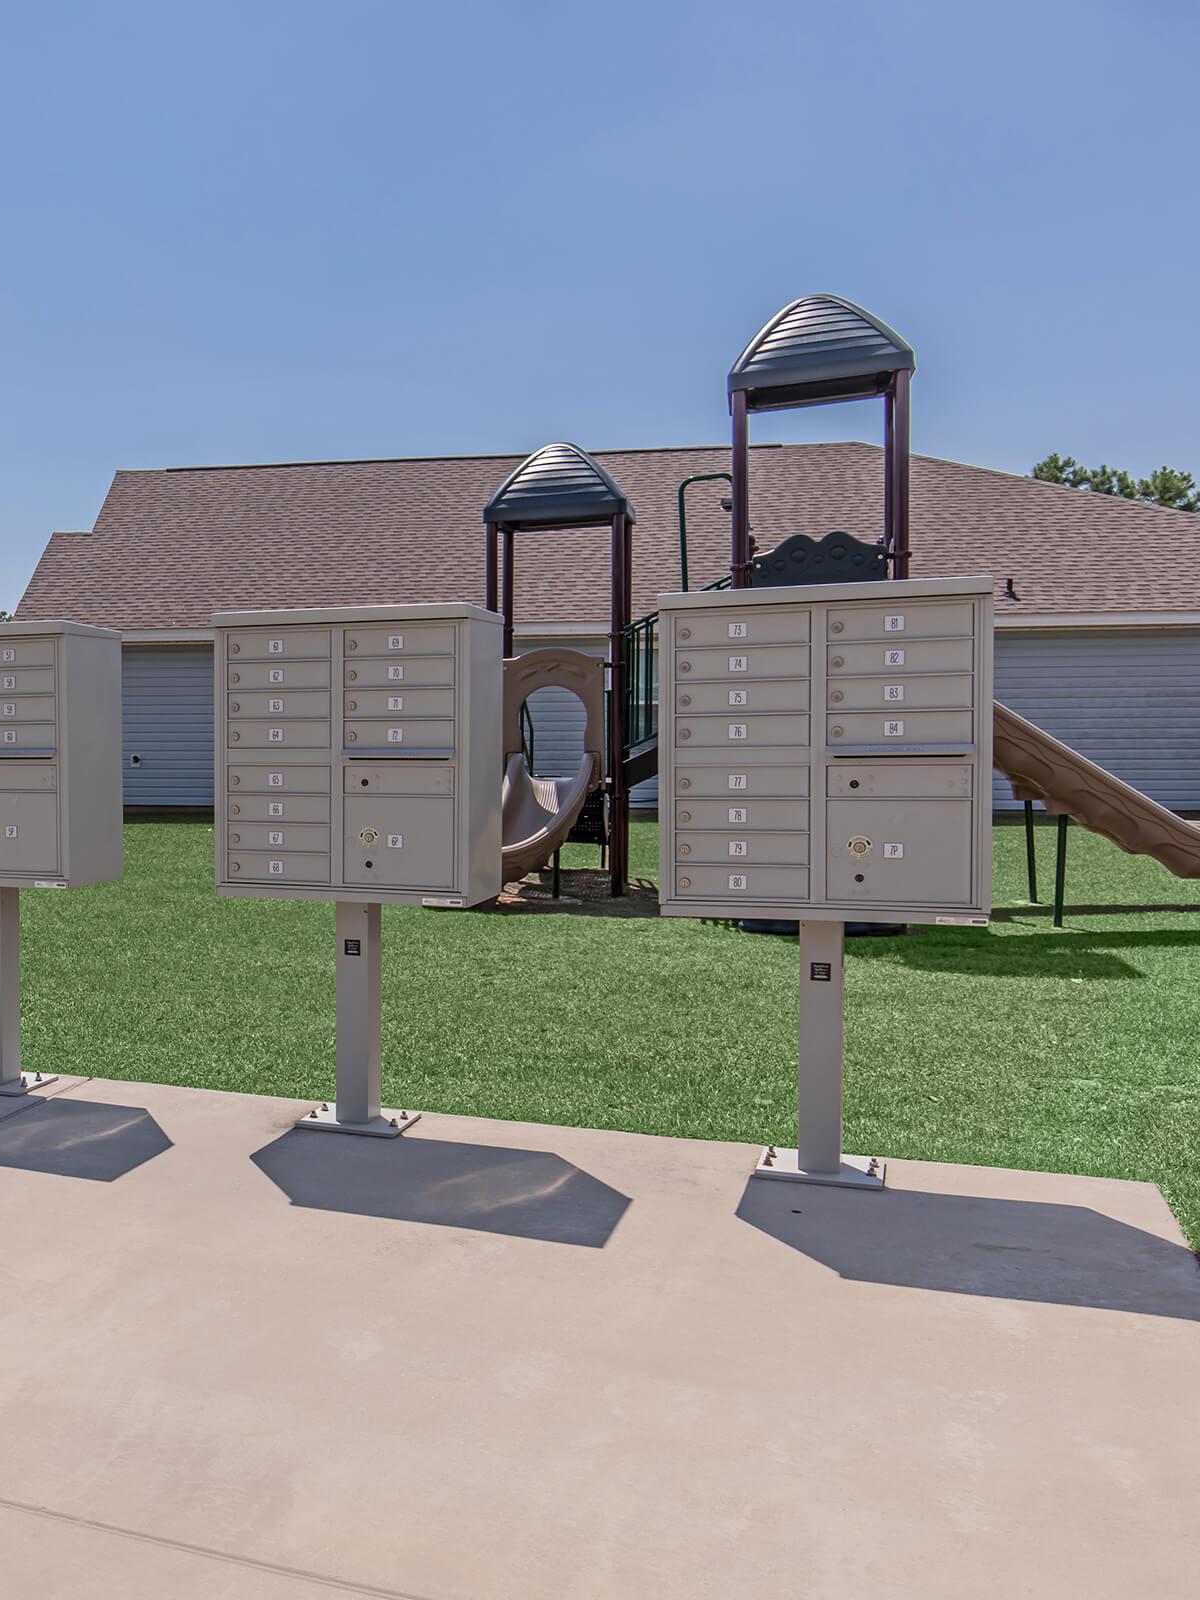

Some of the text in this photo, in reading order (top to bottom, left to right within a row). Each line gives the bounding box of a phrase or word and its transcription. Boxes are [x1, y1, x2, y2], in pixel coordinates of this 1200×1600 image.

[891, 618, 898, 629] 81
[734, 625, 741, 636] 73
[890, 652, 899, 663] 82
[734, 659, 742, 669] 74
[273, 672, 279, 680] 62
[393, 668, 399, 677] 70
[734, 693, 742, 703] 75
[889, 688, 898, 699] 83
[273, 701, 280, 711] 63
[734, 726, 742, 737] 76
[889, 723, 898, 734] 84
[272, 730, 279, 740] 64
[392, 730, 398, 740] 72
[272, 775, 279, 784] 65
[734, 777, 742, 787] 77
[273, 805, 279, 814] 66
[734, 810, 742, 821] 78
[273, 834, 279, 843] 67
[735, 843, 742, 854] 79
[890, 845, 897, 856] 7P
[273, 863, 279, 872] 68
[733, 877, 742, 888] 80
